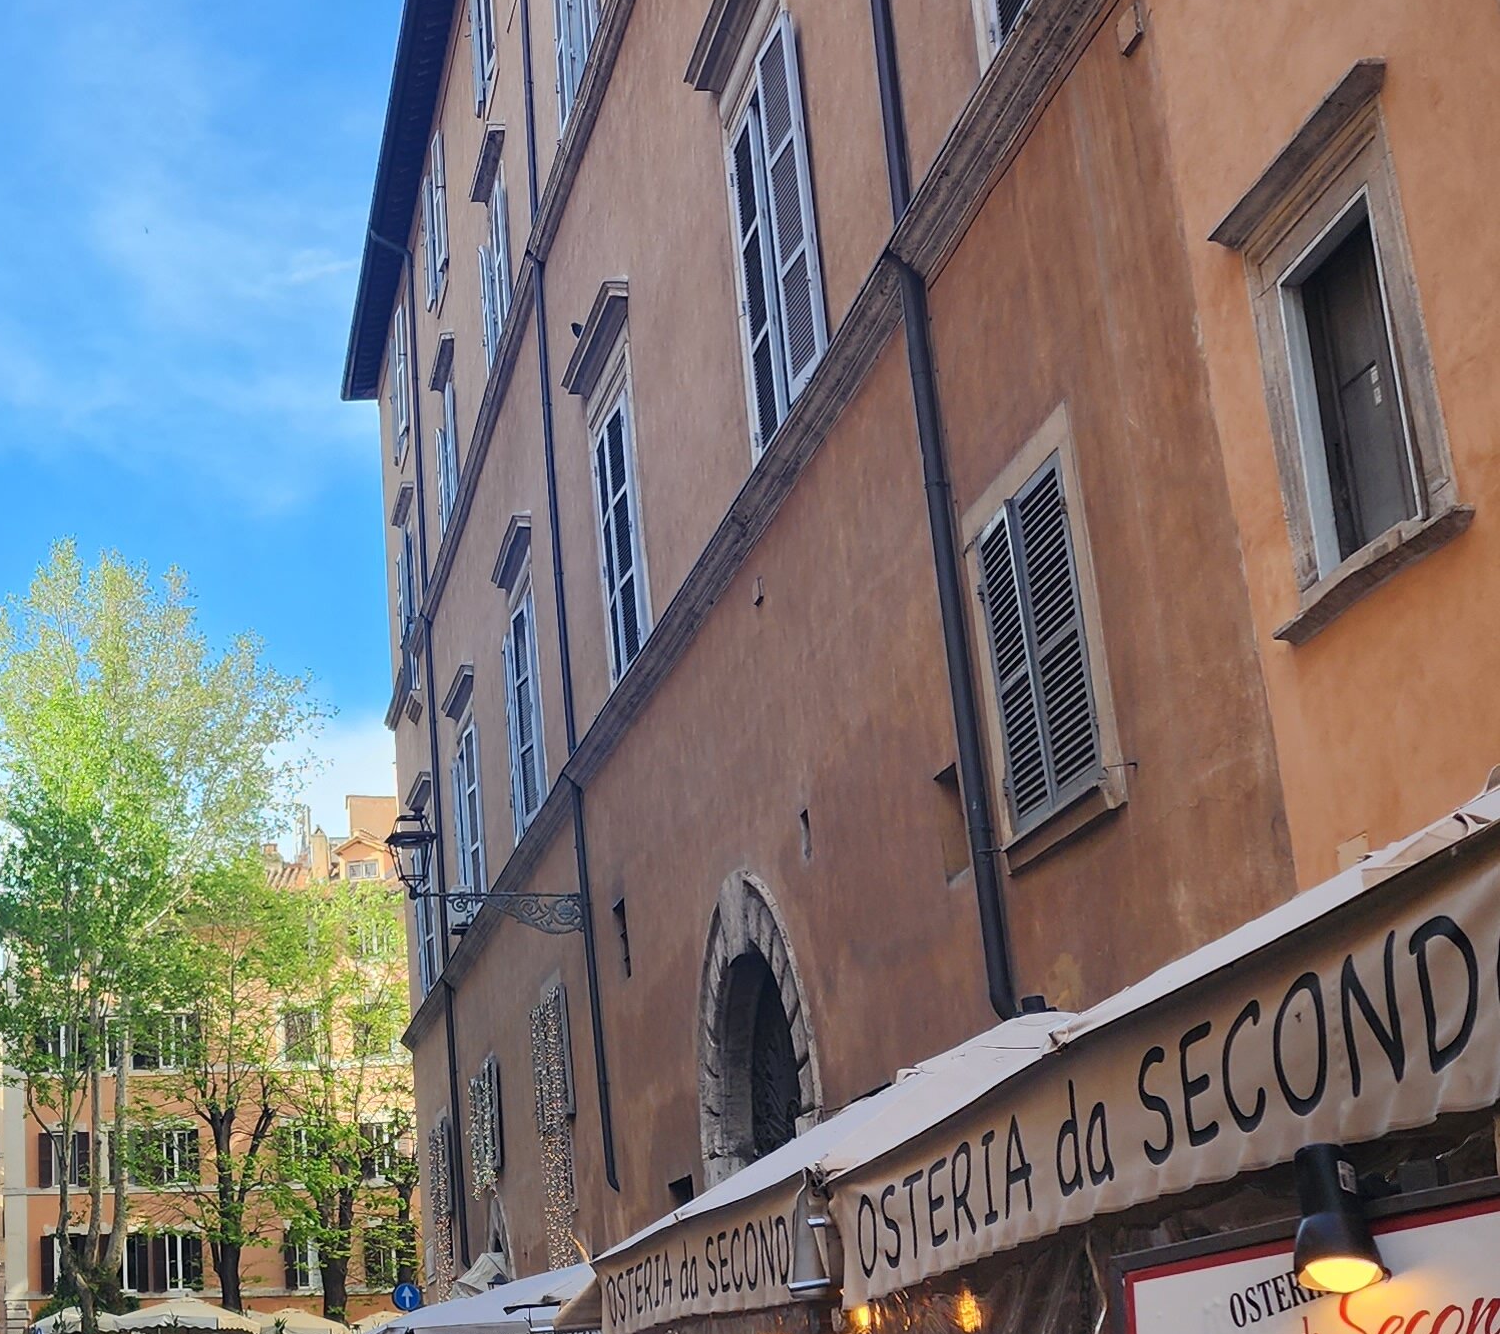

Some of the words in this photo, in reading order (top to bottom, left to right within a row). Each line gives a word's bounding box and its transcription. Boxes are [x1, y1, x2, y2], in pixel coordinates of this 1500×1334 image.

[858, 1115, 1032, 1278] OSTERIA
[1057, 1079, 1114, 1197] da
[1138, 916, 1500, 1165] SECOND
[606, 1250, 672, 1327] OSTERIA
[680, 1241, 699, 1301] da
[706, 1209, 796, 1296] SECOND
